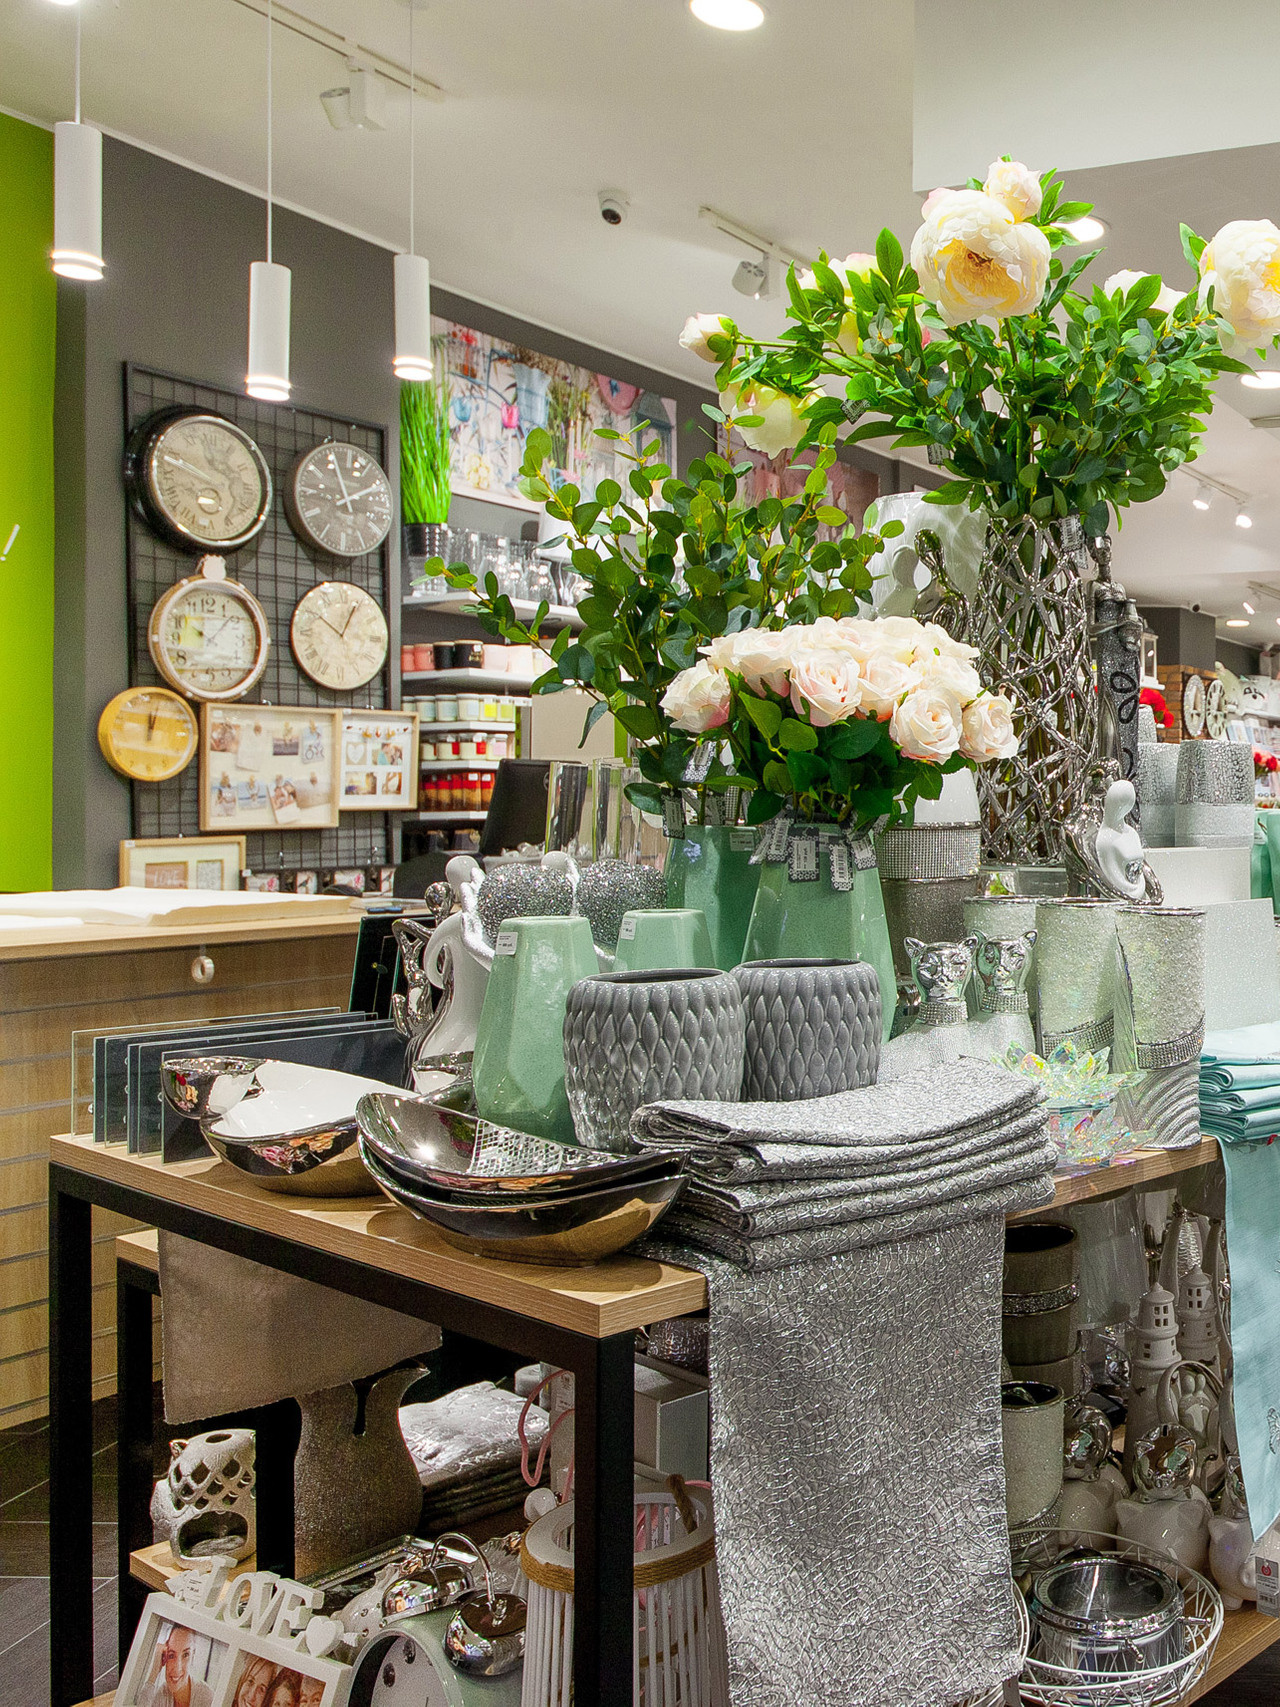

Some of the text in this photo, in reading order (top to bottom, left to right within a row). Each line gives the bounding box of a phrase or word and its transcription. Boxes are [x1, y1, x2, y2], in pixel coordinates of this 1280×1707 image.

[201, 597, 216, 613] 12
[176, 650, 187, 666] 8
[198, 1554, 324, 1651] LOVE
